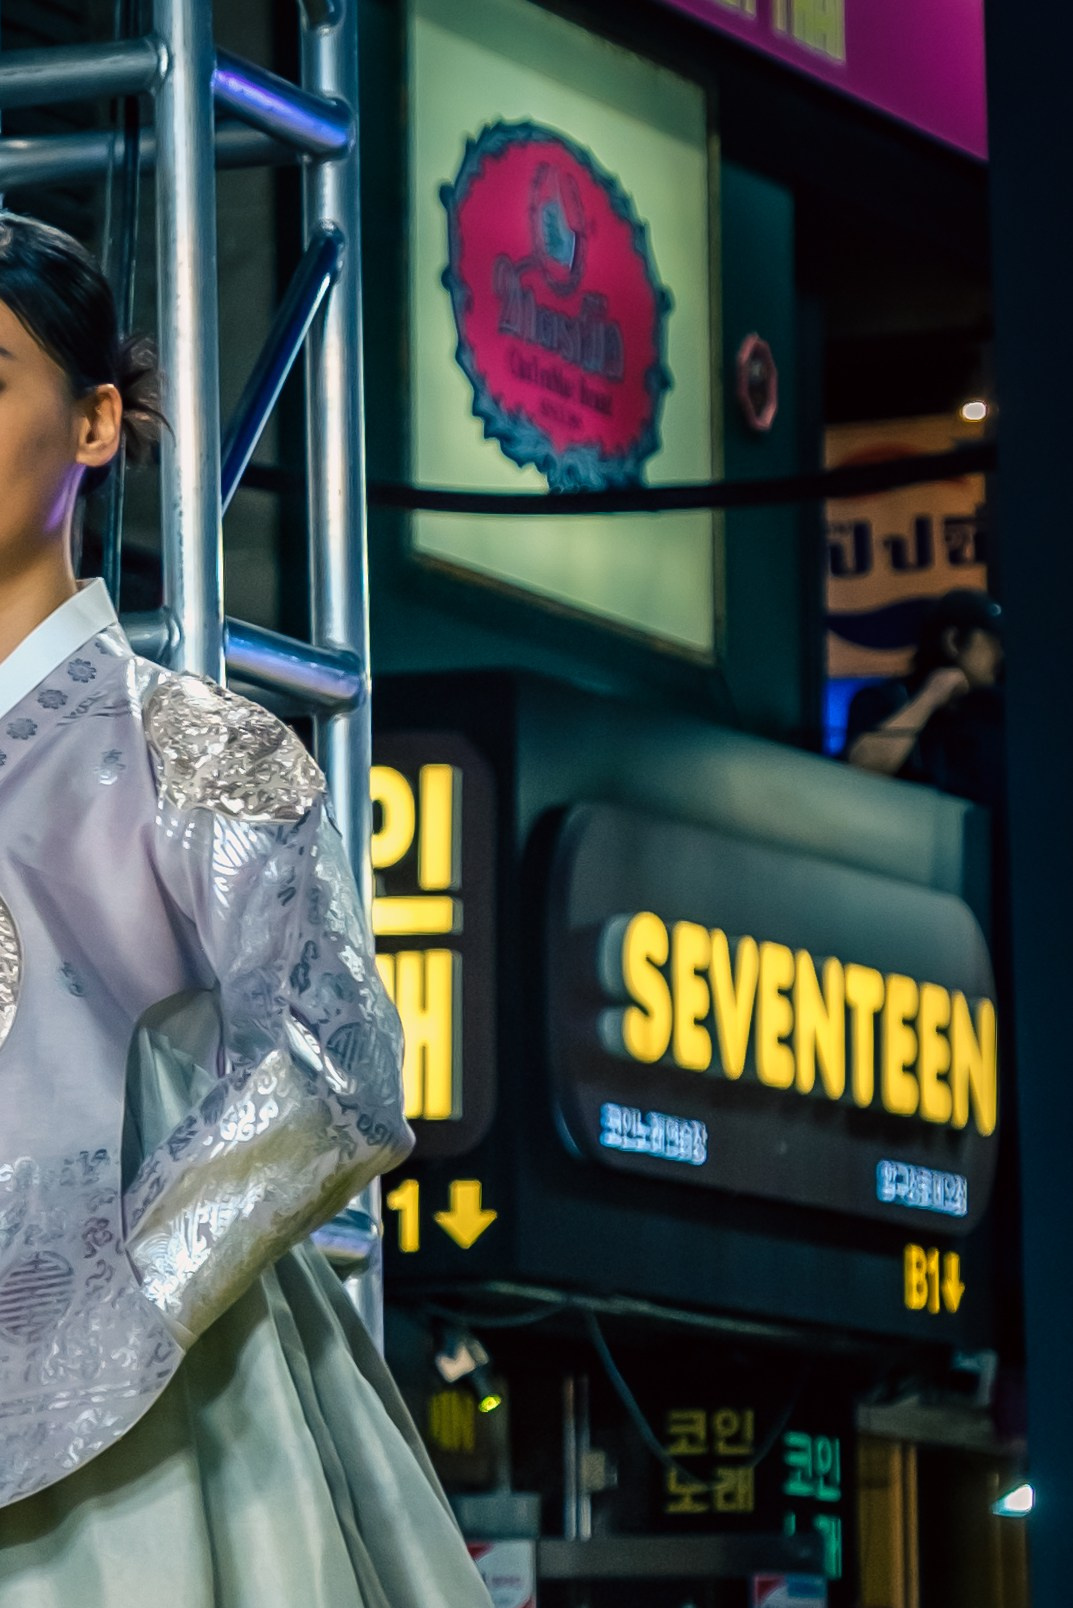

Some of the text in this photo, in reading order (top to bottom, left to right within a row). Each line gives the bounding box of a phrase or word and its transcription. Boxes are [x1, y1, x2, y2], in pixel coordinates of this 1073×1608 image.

[623, 911, 996, 1137] SEVENTEEN
[903, 1243, 940, 1315] B1
[667, 1410, 754, 1455] 코인
[784, 1431, 841, 1501] 코인
[666, 1466, 754, 1513] 노래
